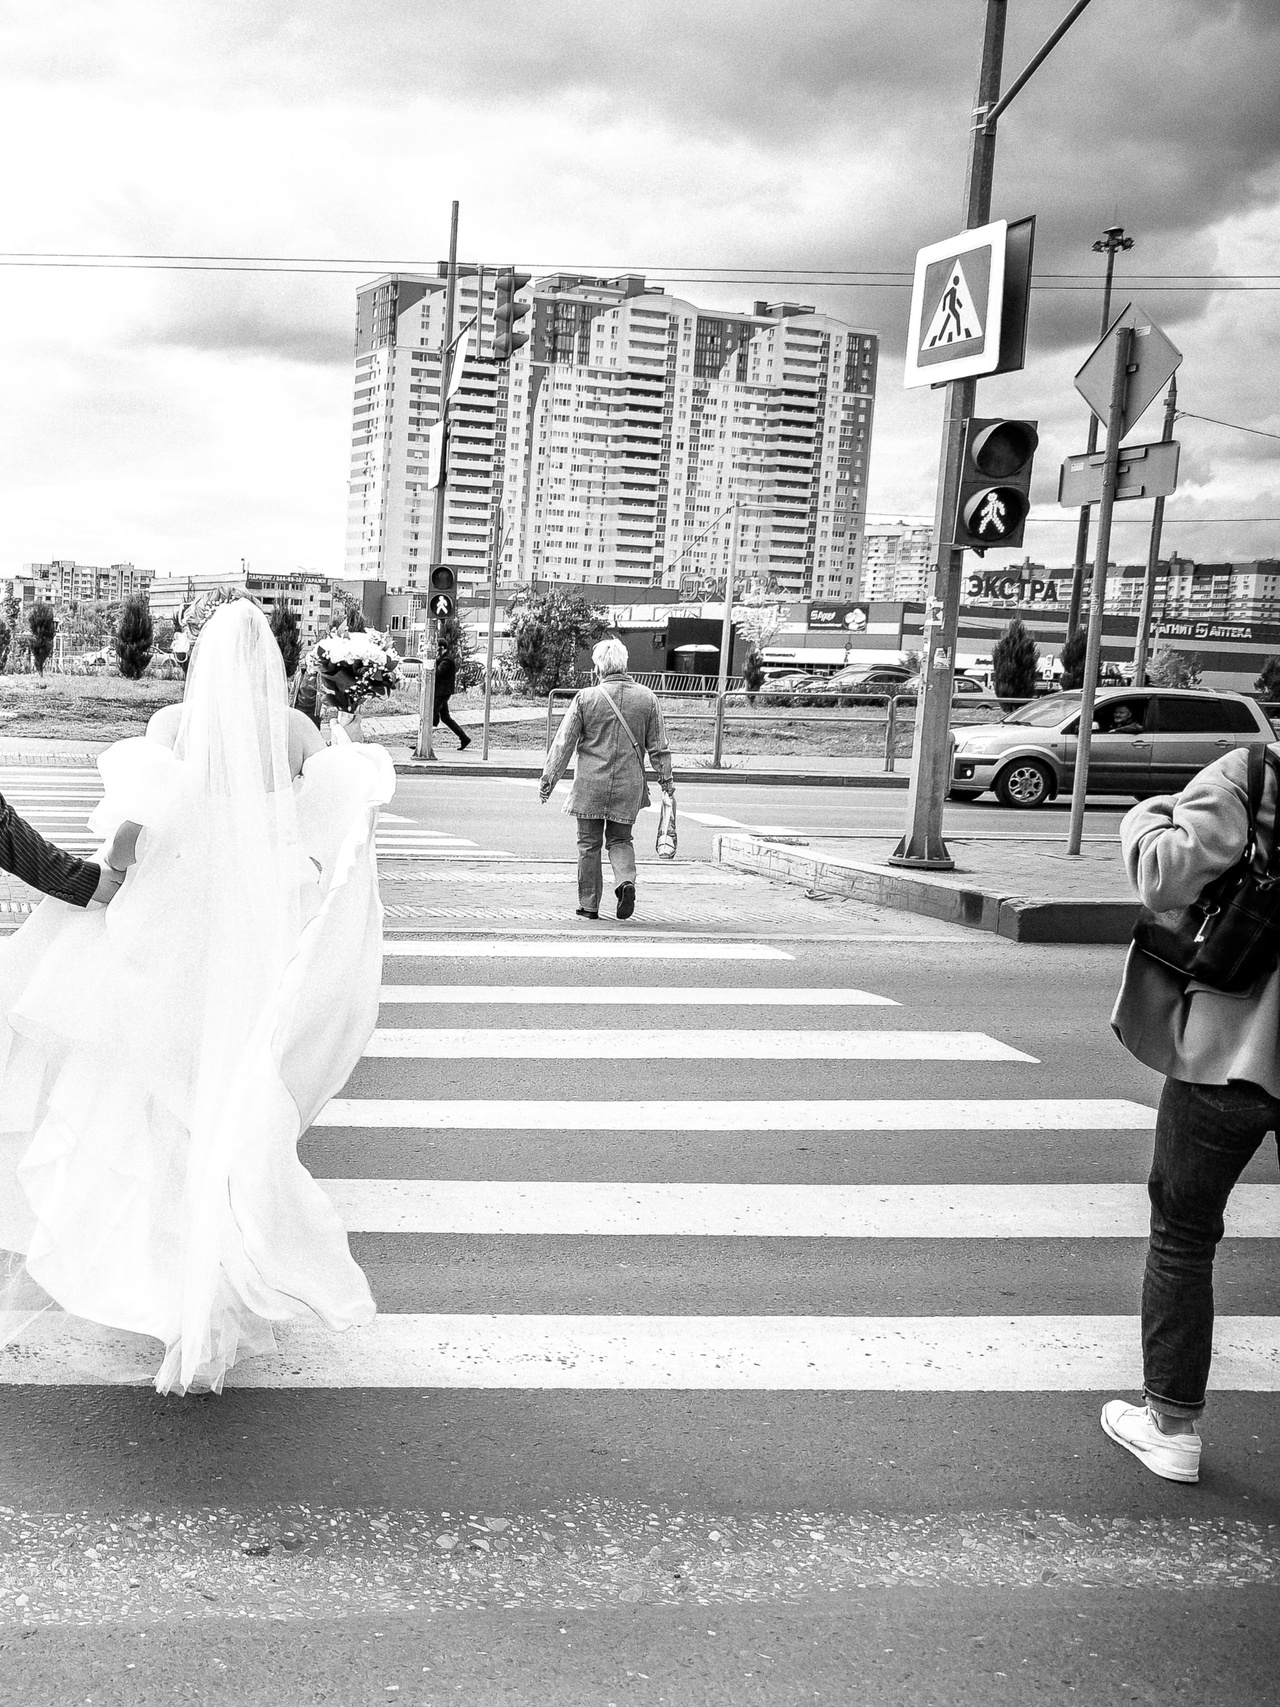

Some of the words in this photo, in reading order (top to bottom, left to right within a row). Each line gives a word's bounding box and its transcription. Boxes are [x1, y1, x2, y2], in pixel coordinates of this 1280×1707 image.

[967, 575, 1058, 601] ЭКСТРА
[1150, 622, 1193, 635] МАГНИТ
[1209, 626, 1252, 638] АПТЕКА
